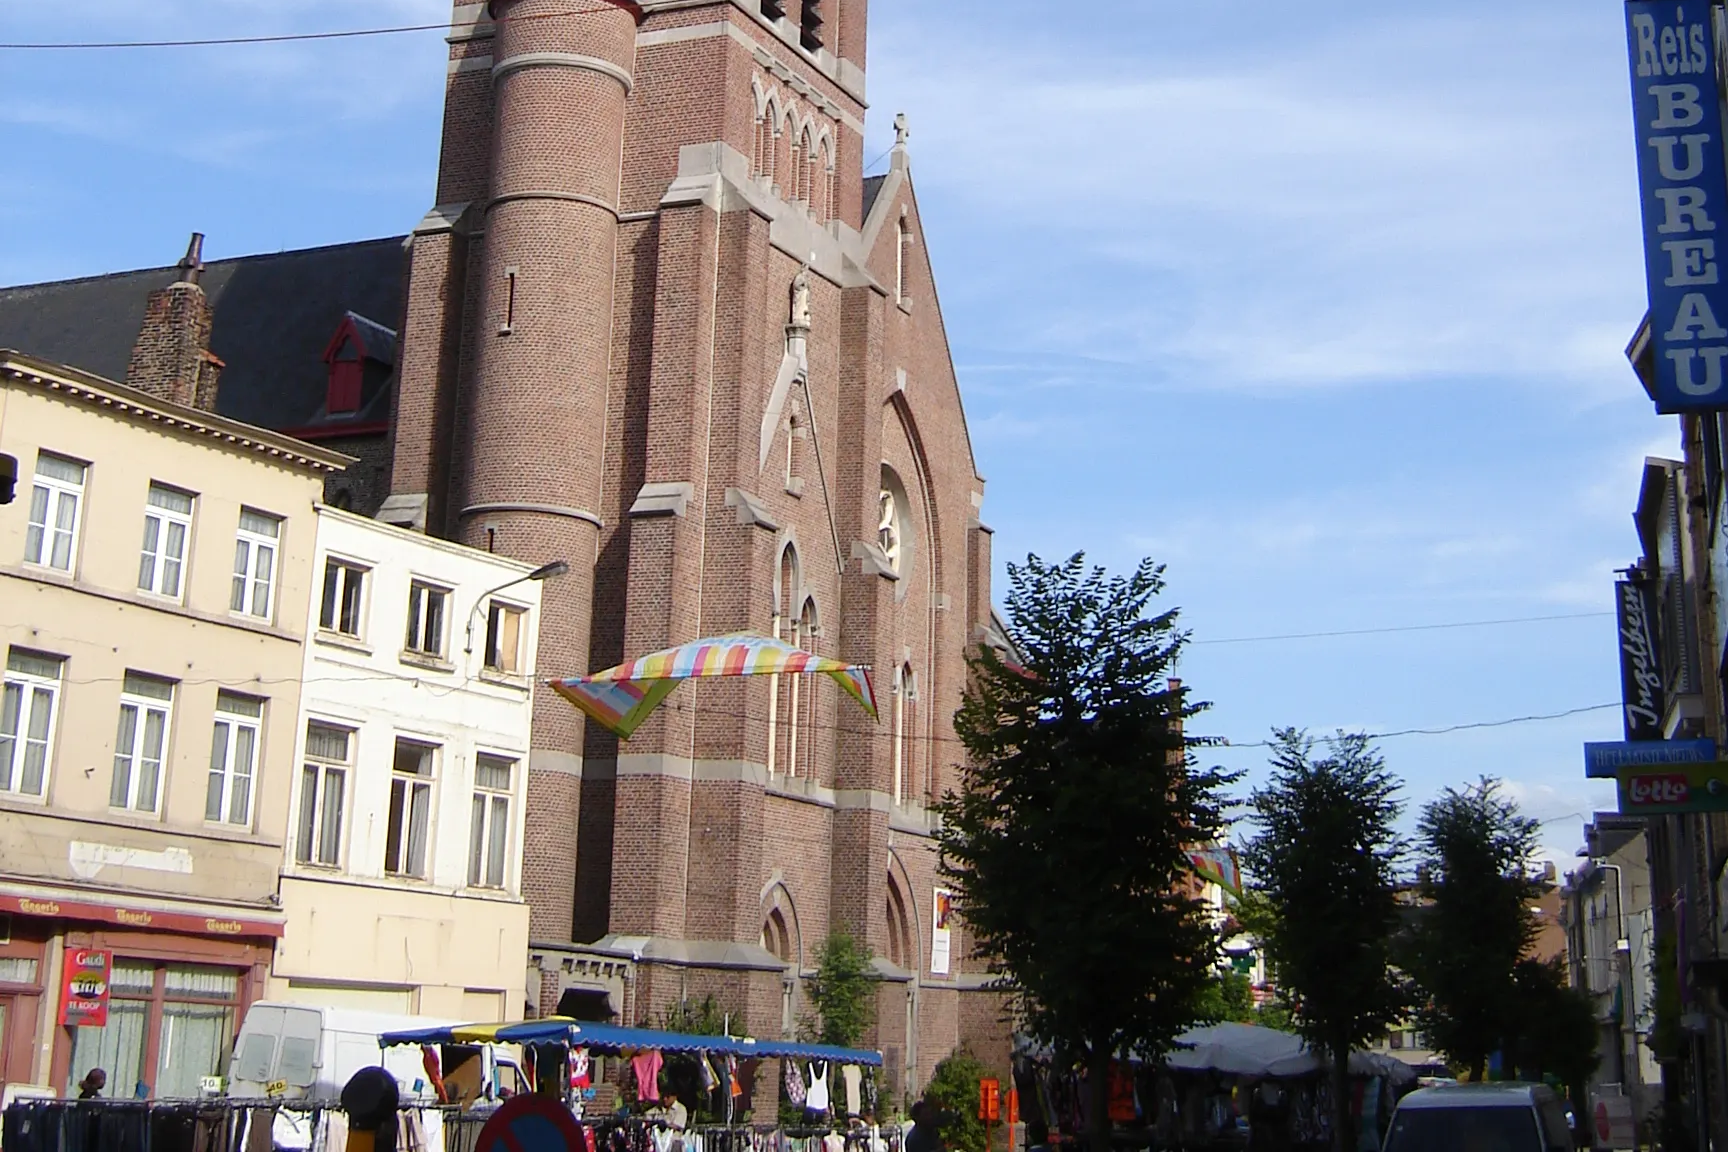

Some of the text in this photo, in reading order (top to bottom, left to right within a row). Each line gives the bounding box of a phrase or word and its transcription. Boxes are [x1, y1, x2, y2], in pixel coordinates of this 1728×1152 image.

[1632, 5, 1707, 77] Reis
[1648, 83, 1728, 396] BUREAU
[1620, 584, 1661, 729] Ingelbeen
